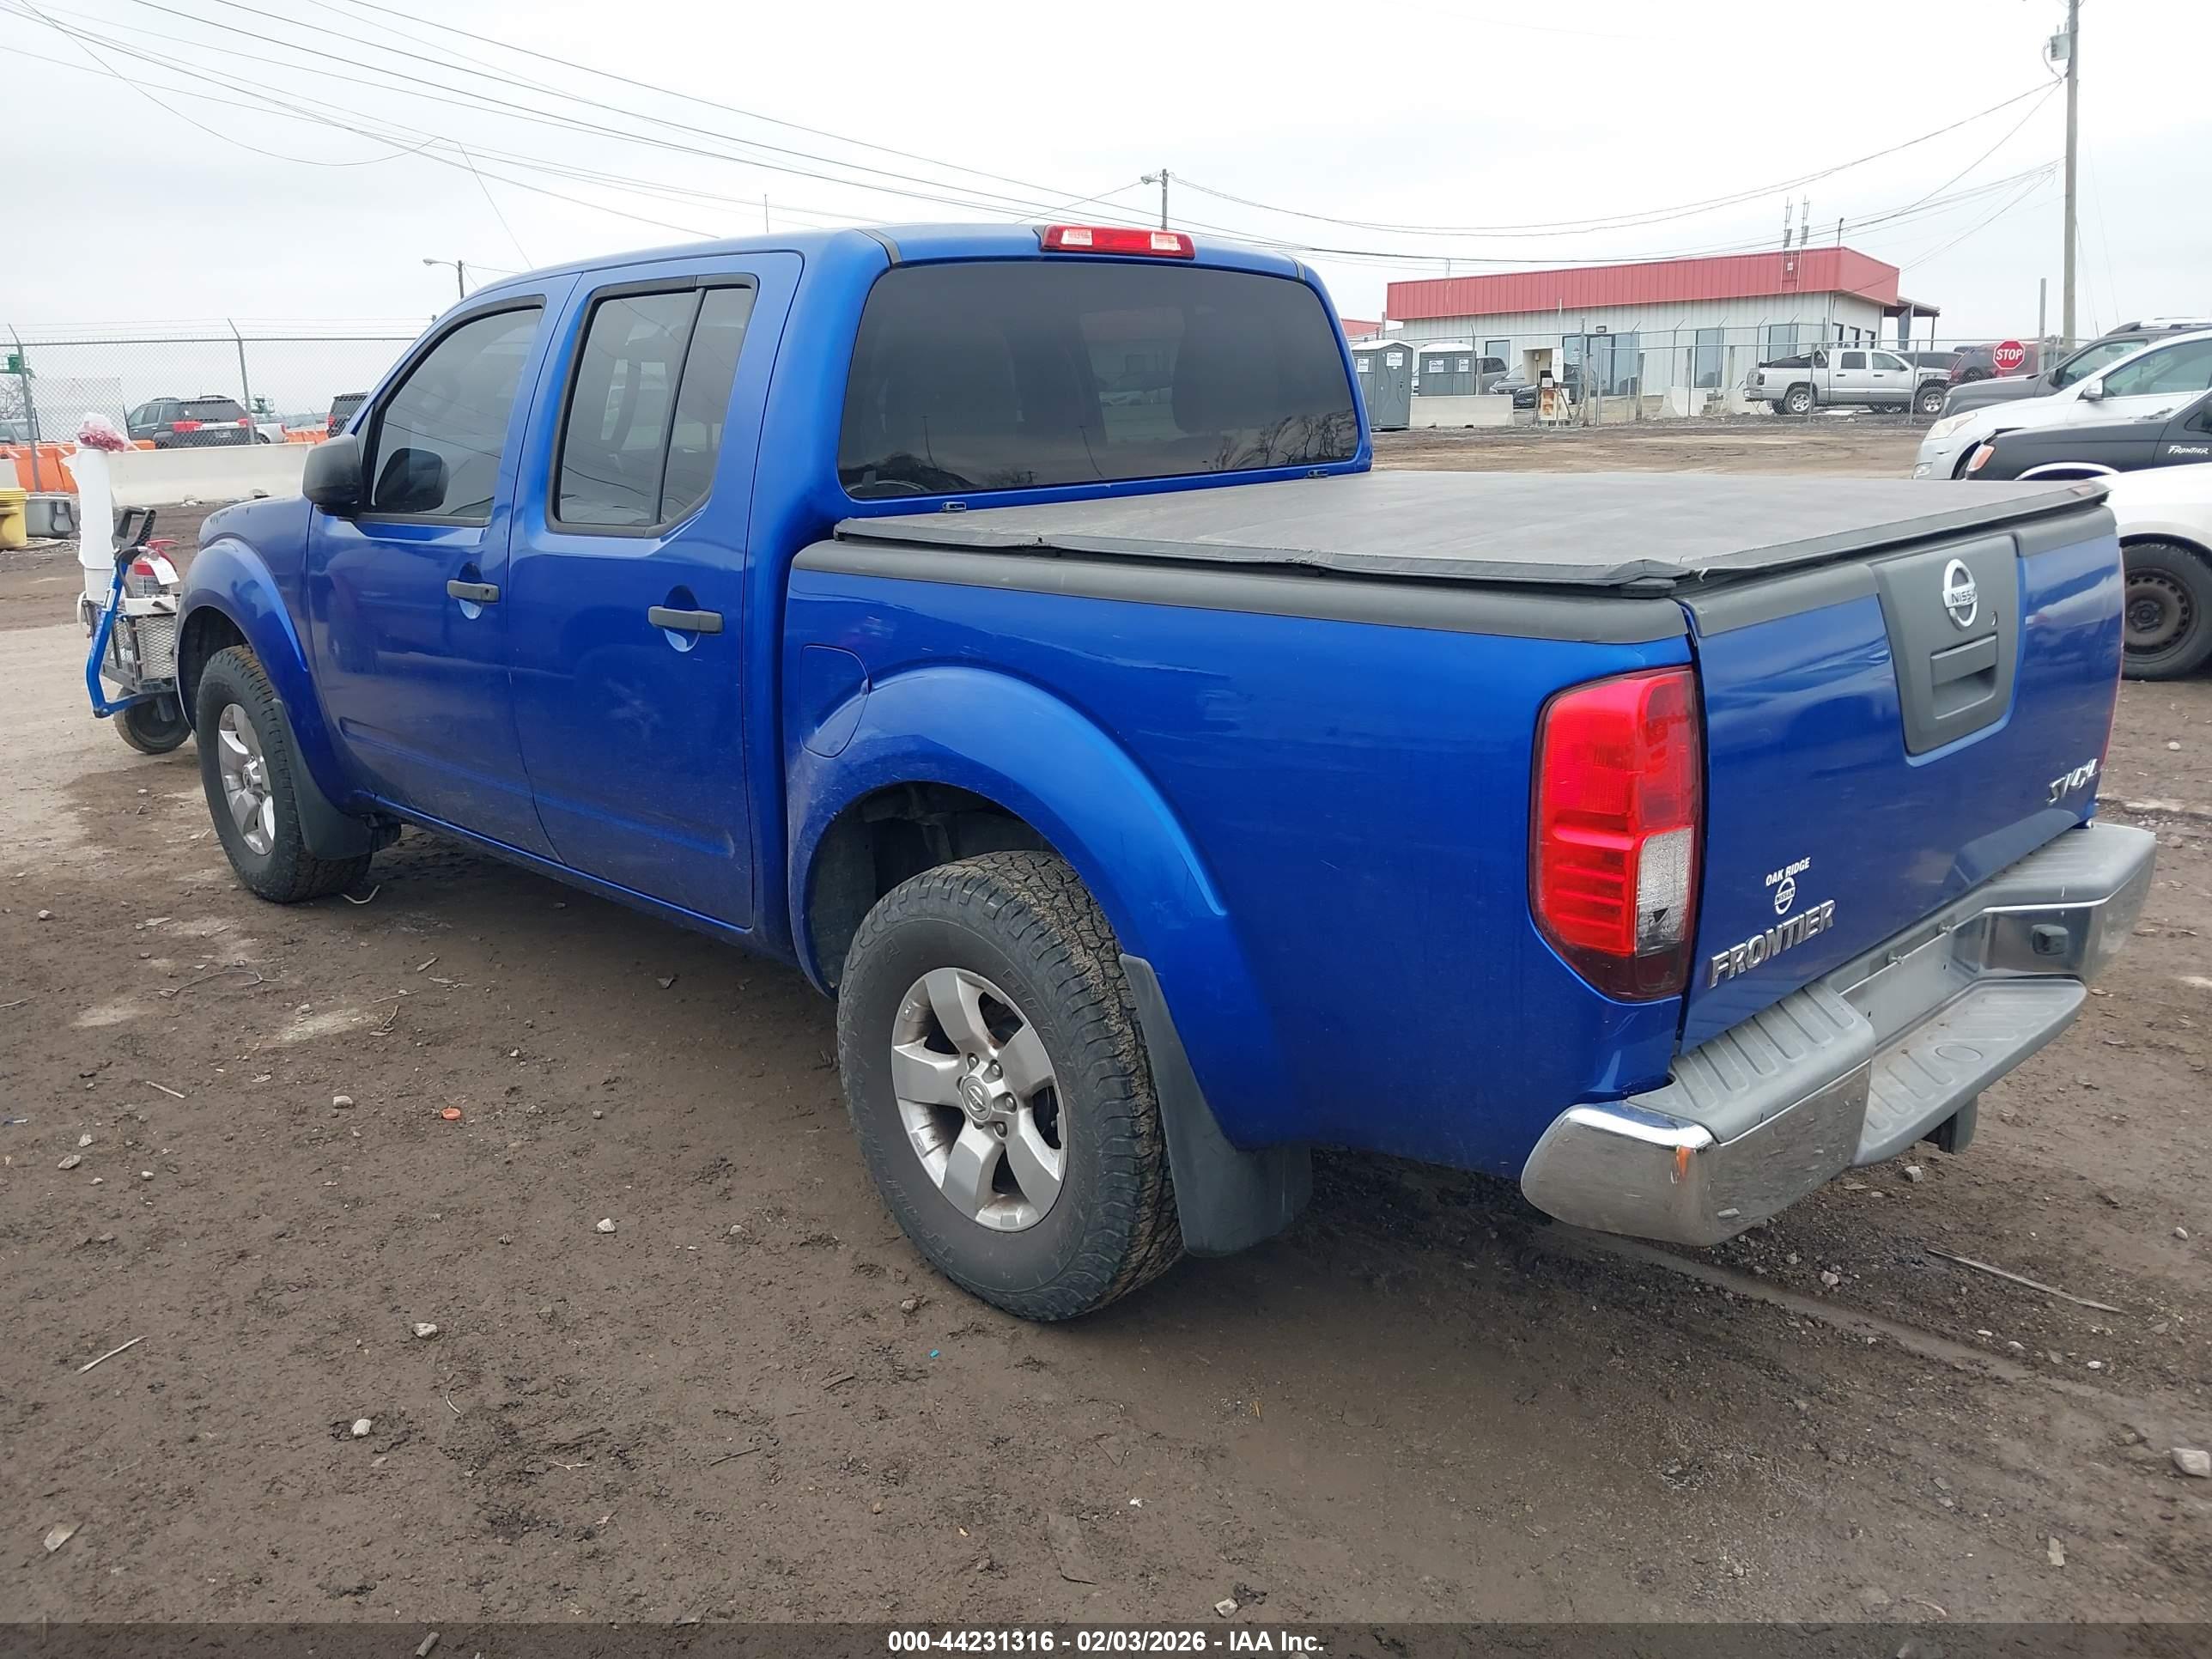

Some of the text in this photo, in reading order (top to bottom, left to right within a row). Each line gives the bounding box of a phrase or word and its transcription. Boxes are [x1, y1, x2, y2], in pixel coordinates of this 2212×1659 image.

[1996, 349, 2023, 361] STOP
[1765, 857, 1811, 887] OAK RIDGE
[1776, 888, 1795, 902] NISSAN
[1709, 899, 1836, 989] FRONTIER
